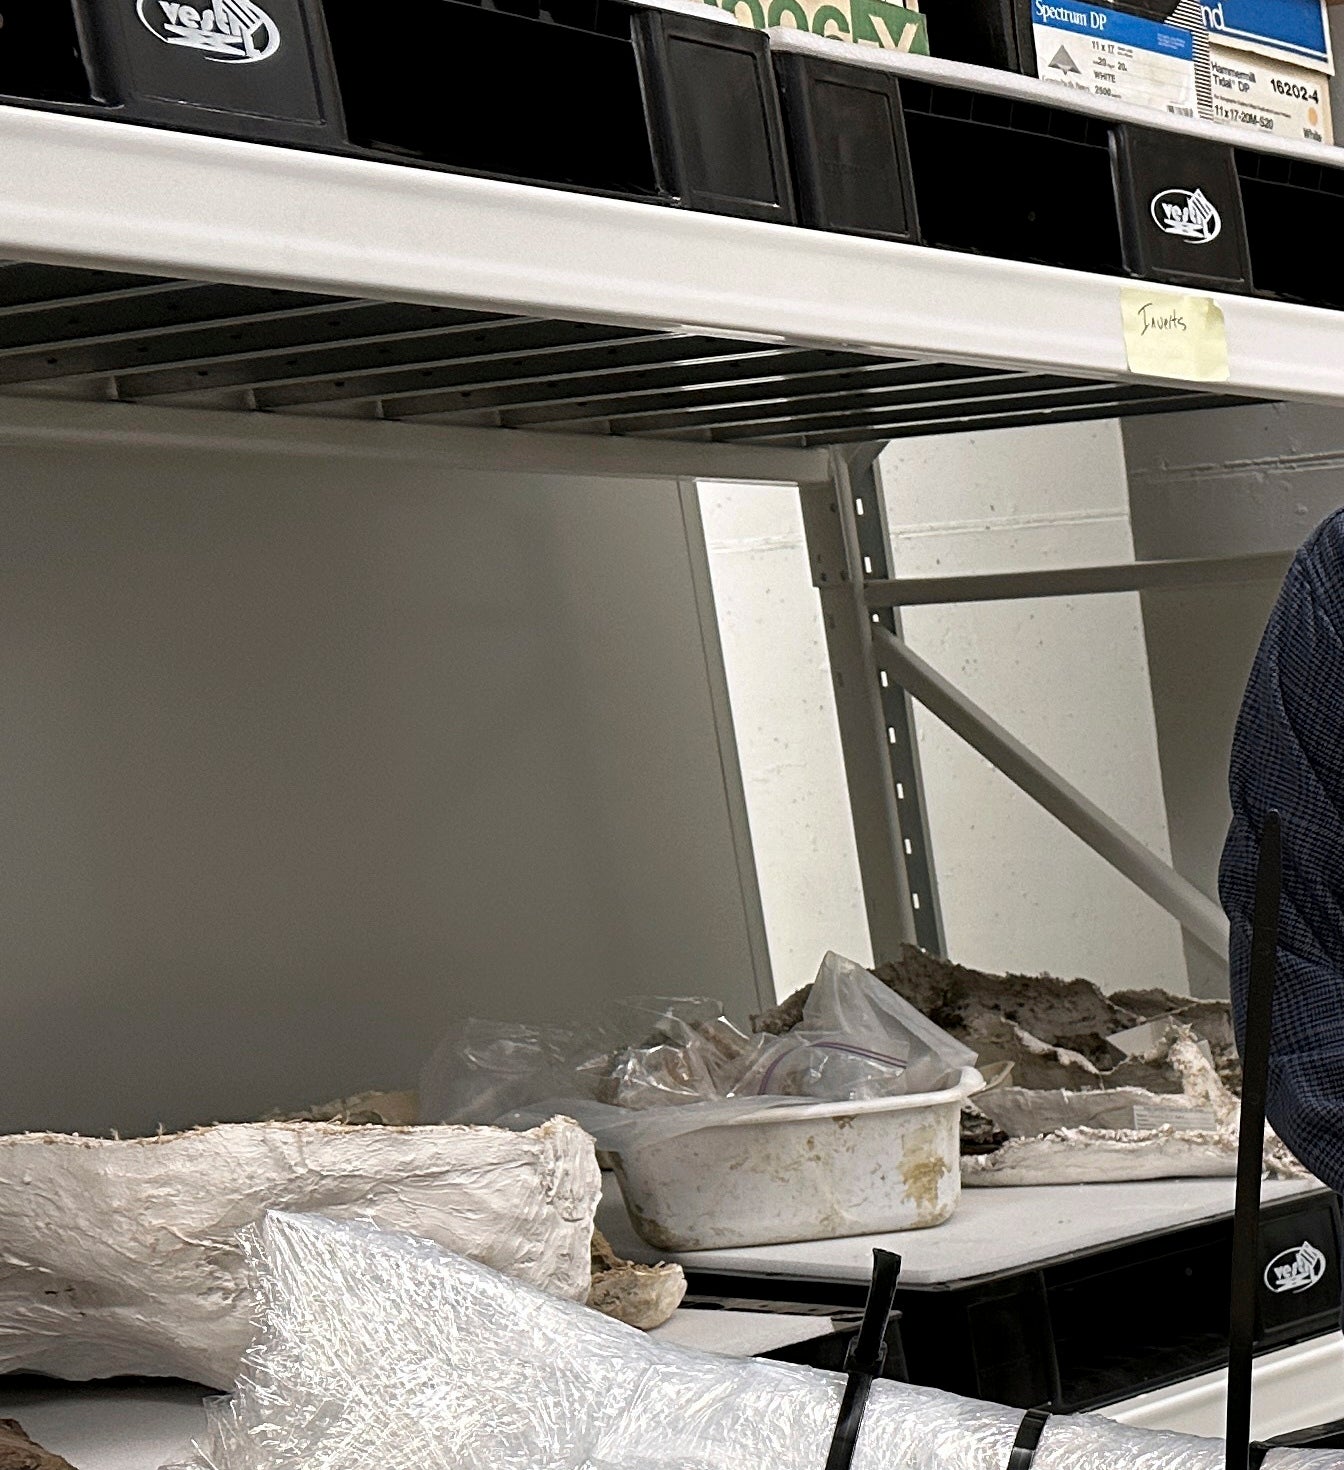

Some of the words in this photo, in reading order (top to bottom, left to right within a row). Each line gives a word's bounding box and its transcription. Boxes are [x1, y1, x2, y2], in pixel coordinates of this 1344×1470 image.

[1035, 0, 1087, 27] Spectrum
[1090, 11, 1107, 30] DP
[1270, 78, 1319, 104] 16202-4
[1137, 302, 1187, 336] Inverts
